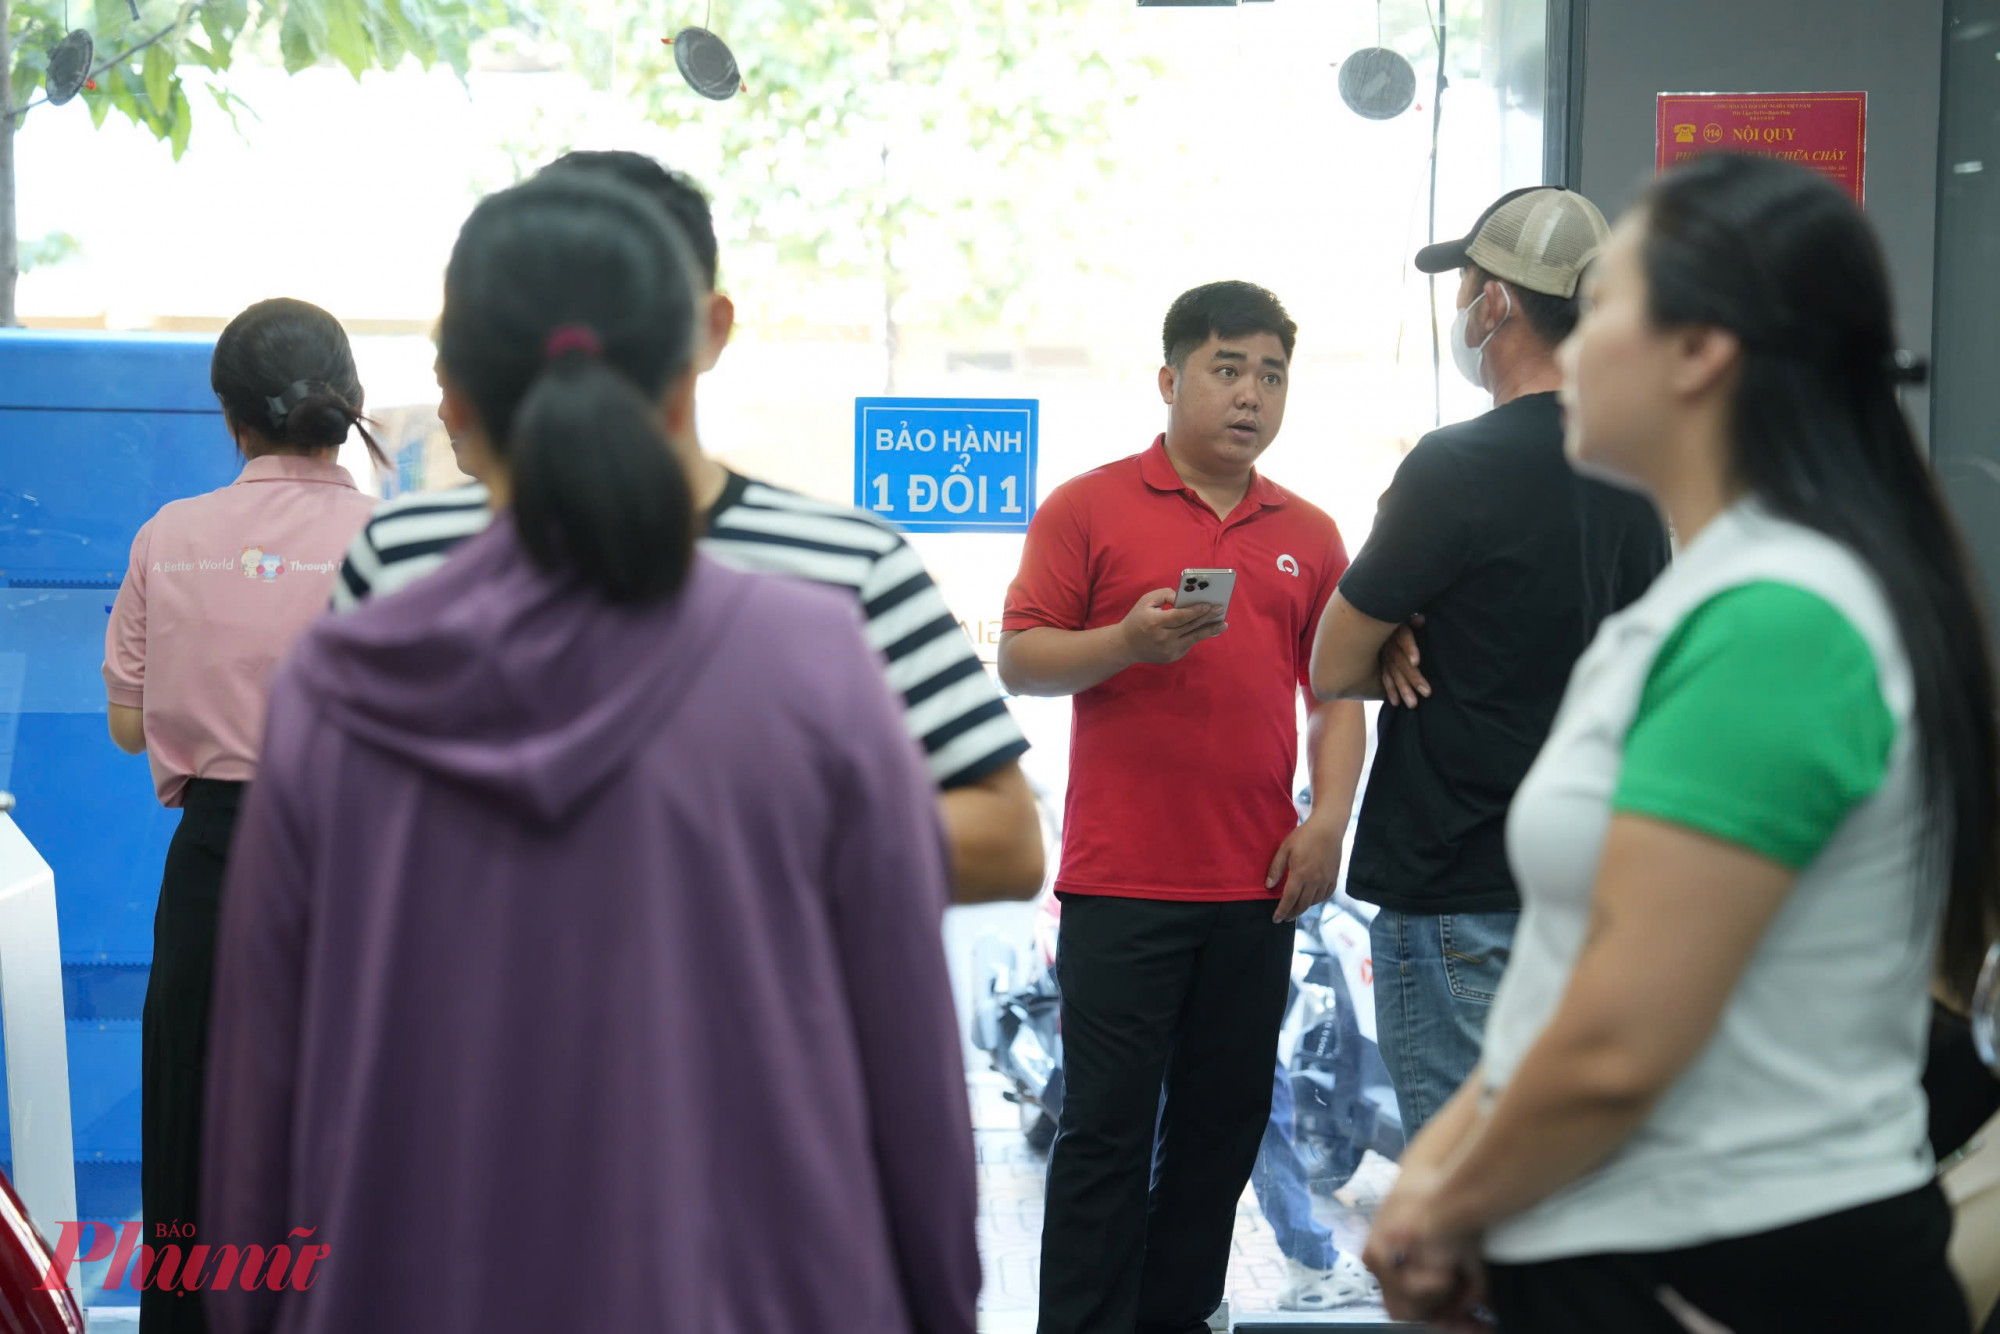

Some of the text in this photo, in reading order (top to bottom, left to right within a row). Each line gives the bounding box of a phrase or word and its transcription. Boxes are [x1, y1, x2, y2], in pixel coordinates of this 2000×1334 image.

[1705, 129, 1720, 138] 114
[1733, 125, 1796, 143] NỘI QUY
[1776, 149, 1809, 161] CHỮA
[1812, 148, 1847, 161] CHÁY
[876, 420, 1022, 453] BẢO HÀNH
[872, 453, 1022, 514] 1 ĐỔI 1
[153, 562, 161, 572] A
[164, 561, 195, 573] Better
[200, 558, 234, 571] World
[291, 561, 334, 573] Through
